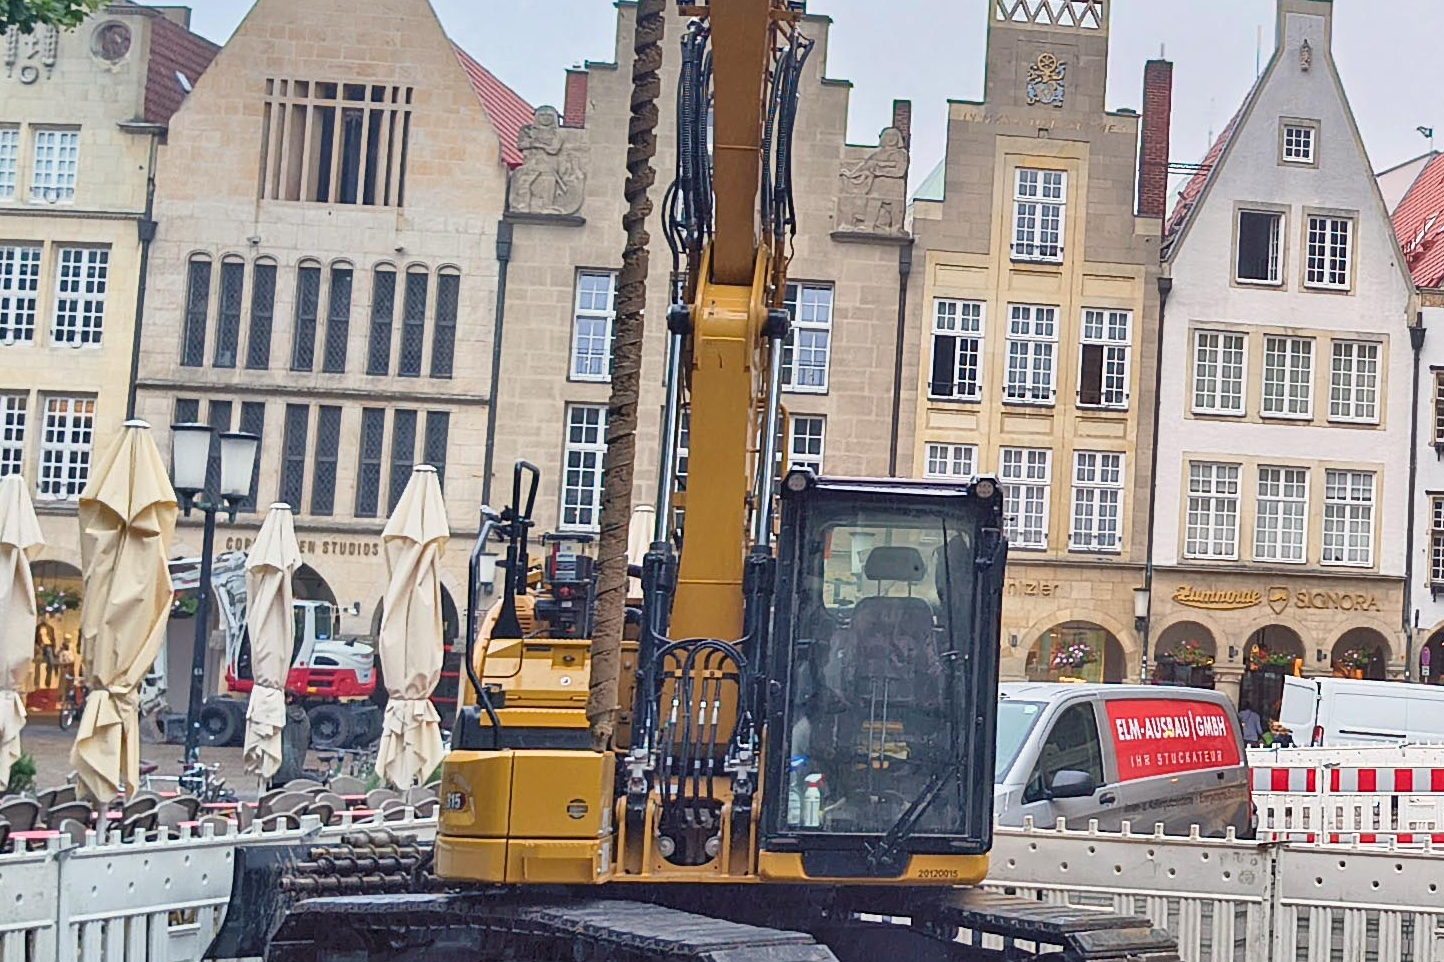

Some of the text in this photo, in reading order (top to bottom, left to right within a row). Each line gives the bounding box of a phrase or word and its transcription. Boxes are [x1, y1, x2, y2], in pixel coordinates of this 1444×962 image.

[322, 540, 379, 556] STUDIOS
[1294, 589, 1381, 612] SIGNORA
[1130, 750, 1222, 768] IHR STUCKATEUR
